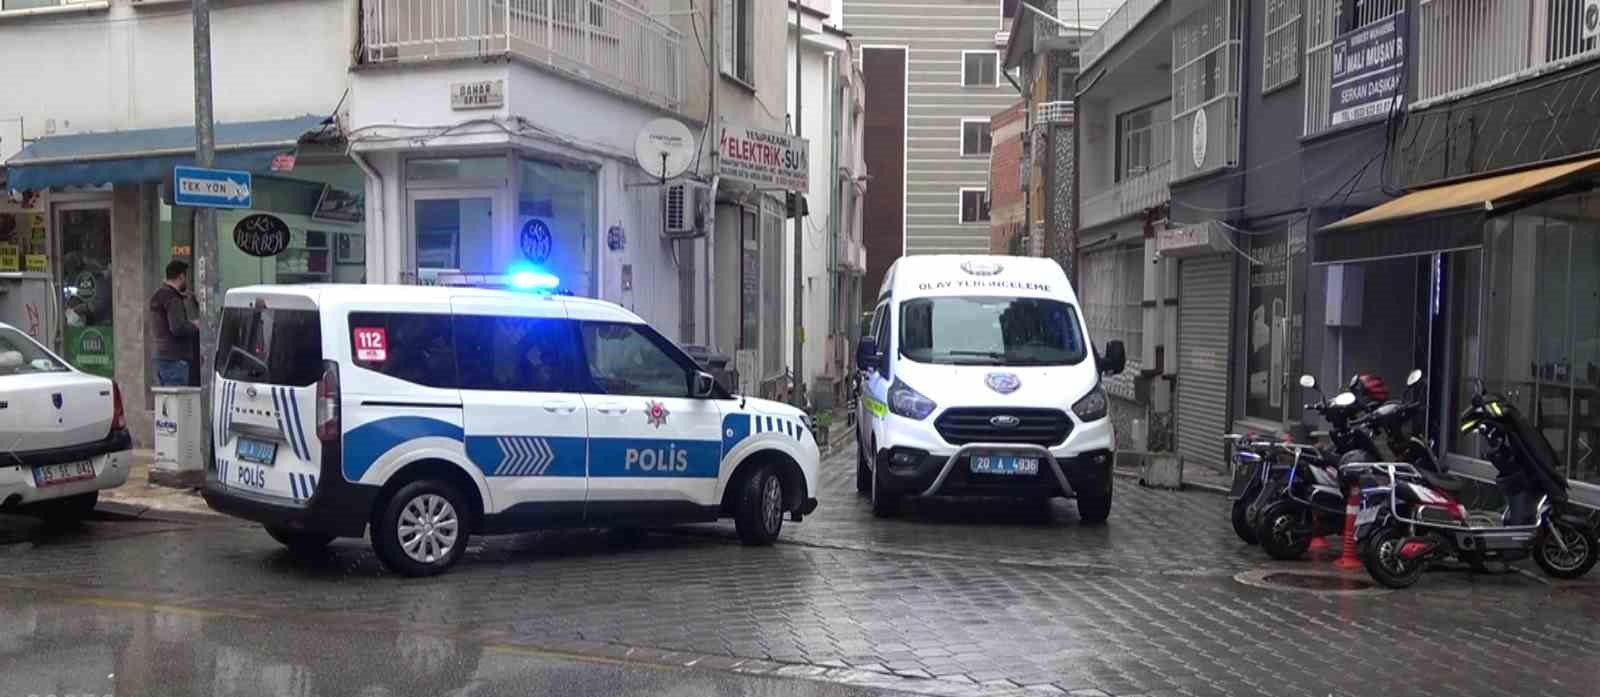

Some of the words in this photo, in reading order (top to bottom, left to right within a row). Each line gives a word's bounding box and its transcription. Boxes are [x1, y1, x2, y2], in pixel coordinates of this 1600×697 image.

[1366, 36, 1403, 69] MÜŞAVR
[182, 181, 201, 191] TEK
[359, 331, 383, 348] 112
[624, 442, 688, 472] POLİS
[238, 464, 265, 488] POLİS
